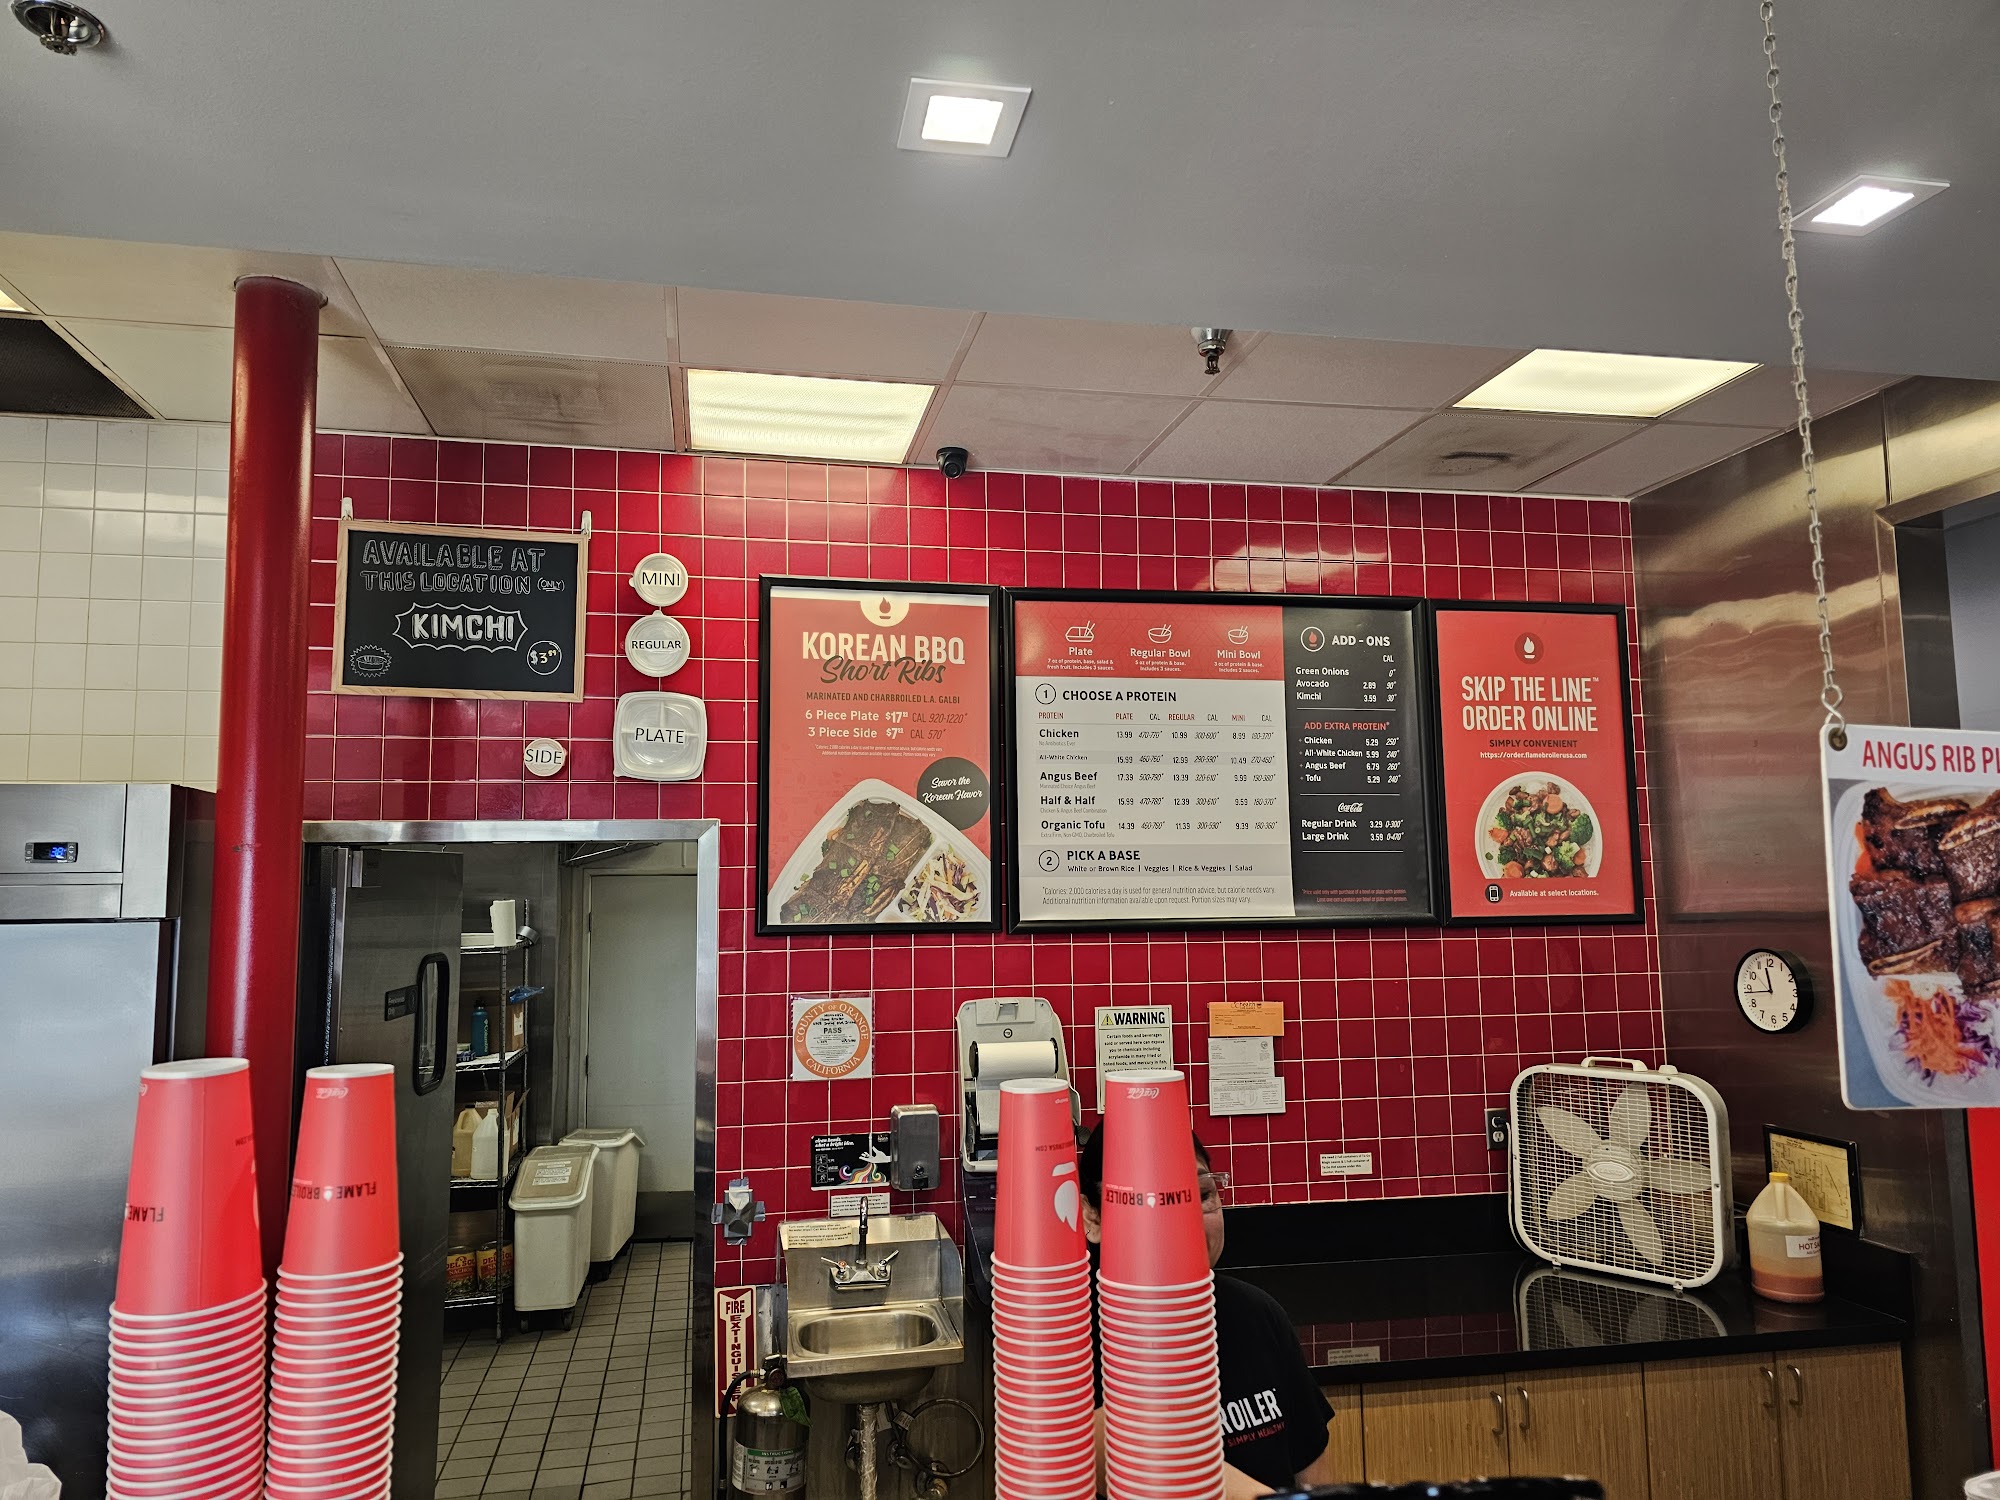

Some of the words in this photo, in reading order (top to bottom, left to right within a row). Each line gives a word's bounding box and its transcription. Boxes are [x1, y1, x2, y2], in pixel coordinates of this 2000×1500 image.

[362, 539, 504, 571] AVAILABLE
[510, 547, 546, 573] AT
[360, 570, 415, 592] THIS
[420, 572, 531, 595] LOCATION
[641, 571, 681, 587] MINI
[411, 613, 515, 642] KIMCHI
[631, 639, 682, 651] REGULAR
[802, 631, 907, 662] KOREAN
[914, 635, 965, 665] BBQ
[1068, 646, 1093, 656] Plate
[1130, 648, 1166, 659] Regular
[1168, 648, 1191, 658] Bowl
[1217, 649, 1237, 659] Mini
[1239, 650, 1261, 659] Bowl
[1382, 655, 1394, 663] CAL
[820, 654, 892, 684] Short
[893, 656, 946, 685] Ribs
[1295, 667, 1320, 675] Green
[1322, 667, 1350, 676] Onions
[1295, 680, 1330, 688] Avocado
[1461, 675, 1506, 702] SKIP
[1510, 676, 1546, 702] THE
[806, 691, 851, 701] MARINATED
[853, 692, 868, 702] AND
[870, 693, 922, 703] CHARBROILED
[923, 694, 937, 704] L.A.
[938, 695, 960, 705] GALBI
[1043, 689, 1048, 699] 1
[1062, 690, 1113, 701] CHOOSE
[1115, 690, 1124, 701] A
[1126, 691, 1177, 702] PROTEIN
[1296, 692, 1322, 700] Kimchi
[805, 709, 813, 720] 6
[816, 710, 847, 721] Piece
[850, 710, 880, 721] Plate
[911, 712, 927, 723] CAL
[1115, 712, 1134, 720] PLATE
[1168, 713, 1195, 721] REGULAR
[1207, 713, 1218, 721] CAL
[1261, 714, 1272, 722] CAL
[1462, 705, 1527, 731] ORDER
[1531, 706, 1598, 732] ONLINE
[1304, 721, 1322, 730] ADD
[1324, 722, 1351, 730] EXTRA
[634, 727, 685, 744] PLATE
[807, 726, 816, 737] 3
[819, 727, 850, 738] Piece
[852, 727, 878, 738] Side
[910, 729, 925, 740] CAL
[1039, 728, 1079, 738] Chicken
[1304, 736, 1333, 745] Chicken
[1489, 739, 1521, 748] SIMPLY
[1523, 740, 1578, 748] CONVENIENT
[524, 748, 563, 766] SIDE
[1304, 749, 1336, 757] All-White
[1337, 749, 1363, 757] Chicken
[1480, 751, 1588, 759] https://order.flamebroilerusa.com
[1862, 739, 1938, 772] ANGUS
[1942, 744, 1976, 773] RIB
[1305, 762, 1328, 771] Angus
[1329, 762, 1346, 770] Beef
[931, 776, 958, 789] Savor
[957, 775, 971, 786] the
[1040, 771, 1072, 782] Angus
[1074, 771, 1098, 781] Beef
[1305, 774, 1321, 782] Tofu
[921, 791, 955, 804] Korean
[955, 789, 983, 801] Flavor
[1040, 795, 1062, 805] Half
[1063, 796, 1072, 805] &
[1074, 795, 1096, 805] Half
[1041, 820, 1082, 832] Organic
[1083, 820, 1105, 830] Tofu
[1301, 819, 1333, 829] Regular
[1334, 819, 1357, 828] Drink
[1369, 820, 1383, 828] 3.29
[1302, 832, 1325, 842] Large
[1326, 832, 1350, 840] Drink
[1046, 856, 1053, 866] 2
[1067, 850, 1095, 861] PICK
[1097, 850, 1106, 861] A
[1109, 850, 1141, 861] BASE
[1144, 865, 1169, 873] Veggies
[1201, 865, 1226, 873] Veggies
[1509, 889, 1538, 897] Available
[1568, 889, 1599, 897] locations.
[1766, 958, 1774, 968] 12
[1749, 971, 1757, 980] 10
[1788, 973, 1794, 983] 2
[1746, 984, 1752, 993] 9
[1792, 988, 1798, 998] 3
[1751, 998, 1757, 1008] 8
[1789, 1003, 1797, 1012] 4
[1113, 1011, 1166, 1026] WARNING
[1759, 1009, 1765, 1019] 7
[1770, 1015, 1777, 1024] 6
[1782, 1012, 1789, 1022] 5
[796, 1003, 825, 1043] COUNTY
[839, 1003, 869, 1040] ORANGE
[805, 1056, 861, 1075] CALIFORNIA
[336, 1180, 378, 1200] FLAME
[1159, 1188, 1193, 1206] FLAME
[127, 1204, 165, 1222] FLAME
[1798, 1242, 1813, 1251] HOT
[725, 1299, 746, 1315] FIRE
[729, 1314, 743, 1402] EXTINGUISER
[1220, 1389, 1283, 1437] ROILER
[1227, 1430, 1257, 1448] SIMPLY
[1257, 1421, 1286, 1439] HEALTHY
